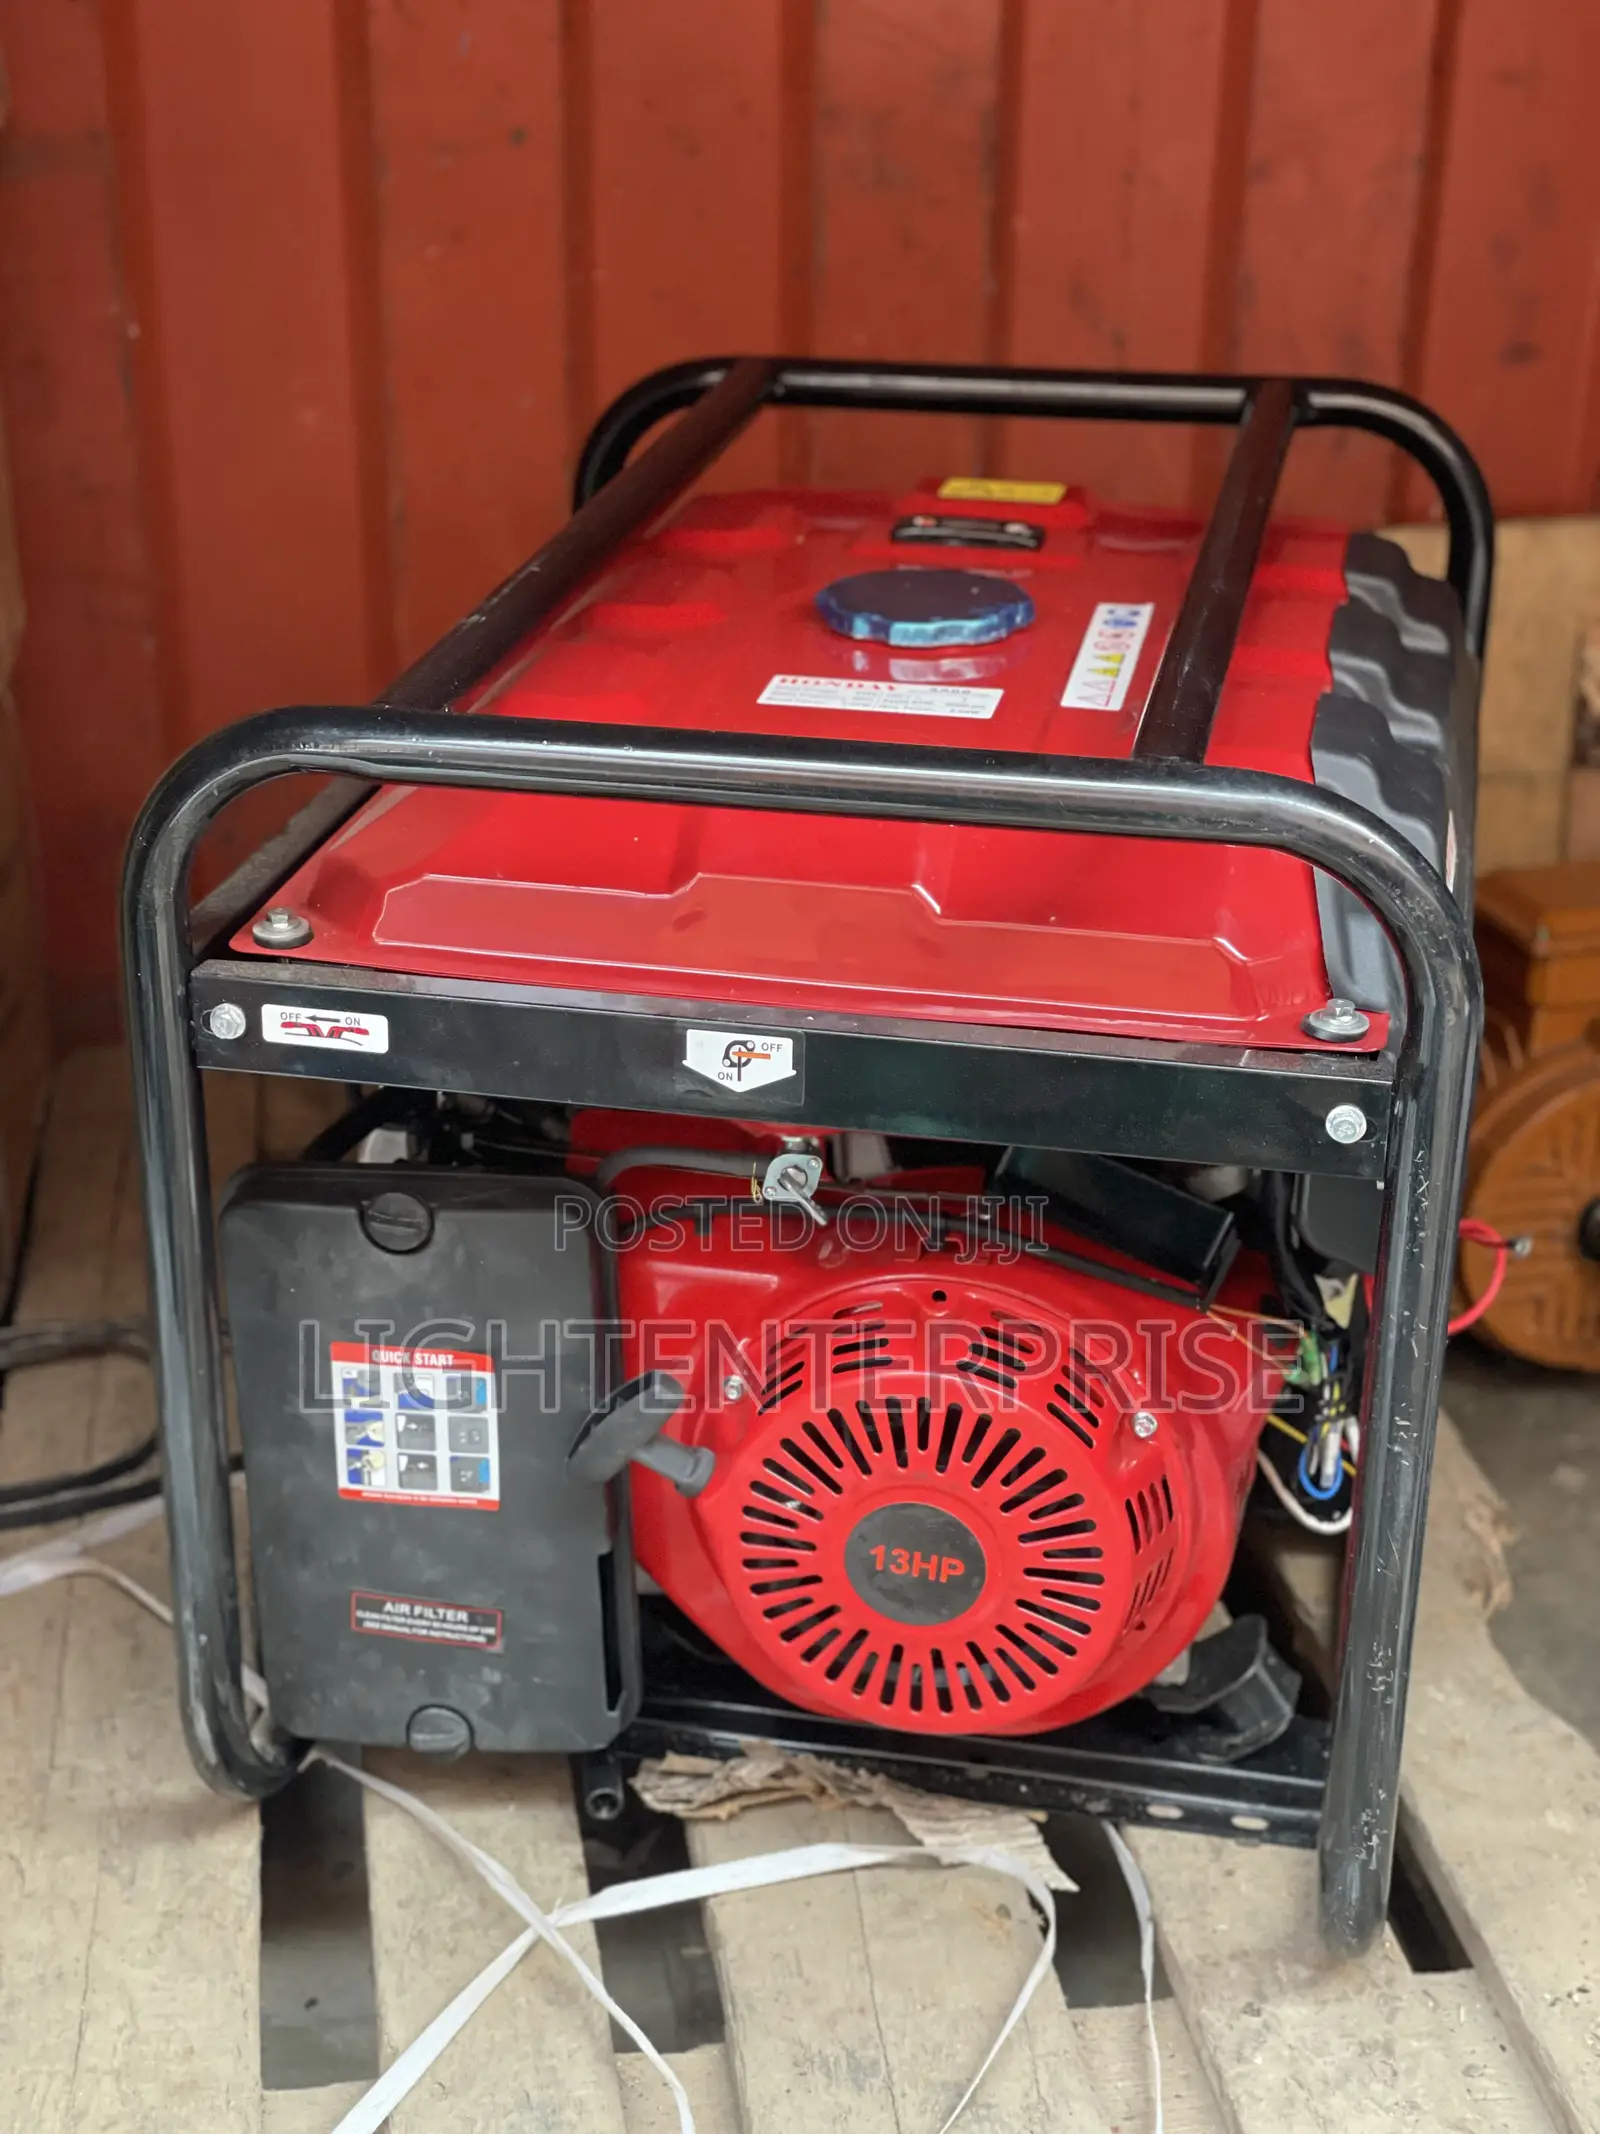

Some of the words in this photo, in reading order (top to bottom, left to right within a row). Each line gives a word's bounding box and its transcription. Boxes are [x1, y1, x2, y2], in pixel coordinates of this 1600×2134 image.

[280, 1011, 302, 1023] OFF
[344, 1016, 361, 1026] ON
[761, 1042, 783, 1053] OFF
[717, 1072, 733, 1081] ON
[371, 1349, 411, 1364] QUICK
[414, 1352, 455, 1366] START
[869, 1544, 966, 1584] 13HP
[383, 1601, 411, 1616] AIR
[413, 1605, 469, 1623] FILTER
